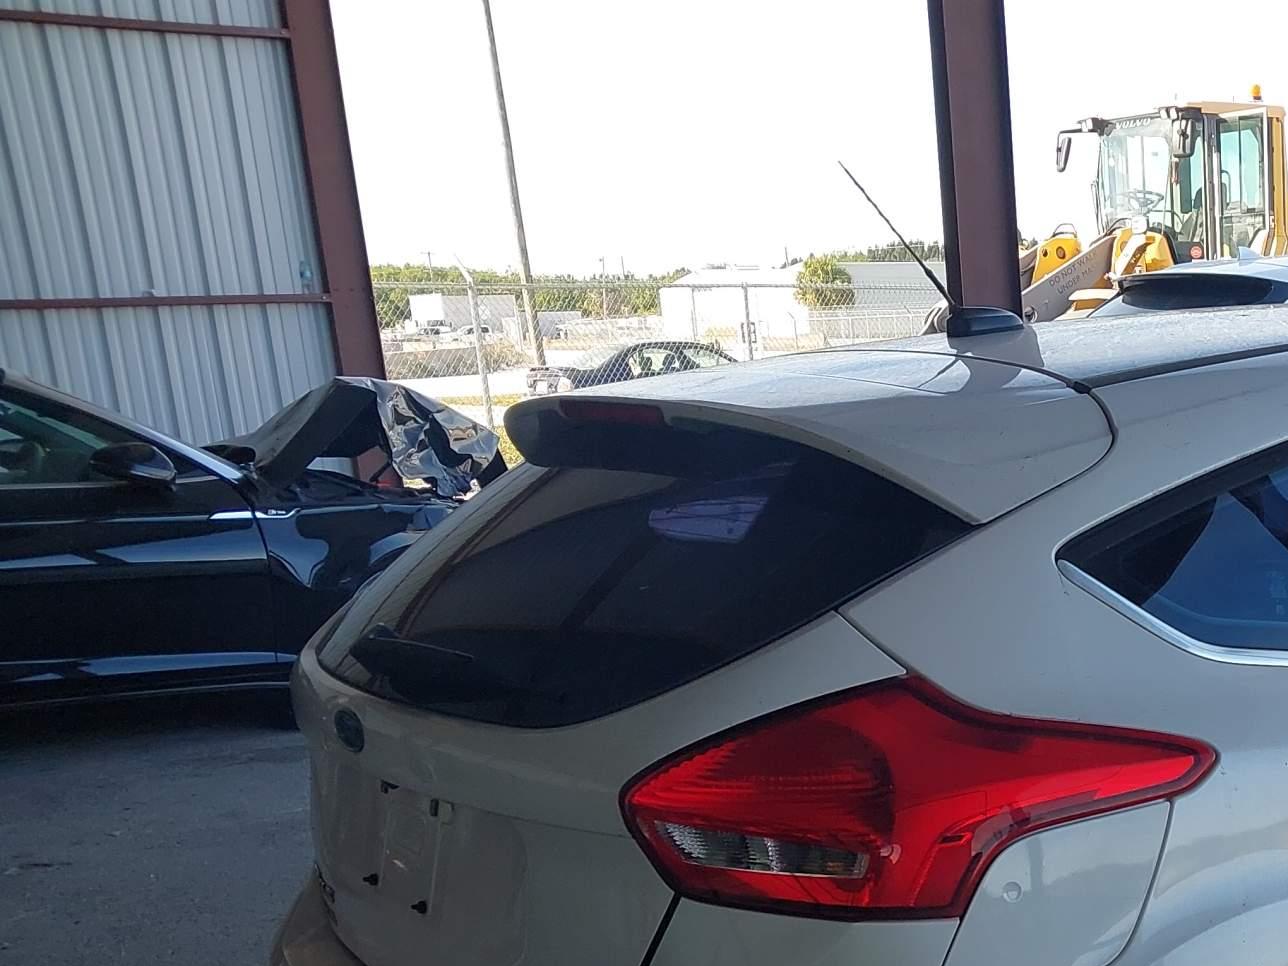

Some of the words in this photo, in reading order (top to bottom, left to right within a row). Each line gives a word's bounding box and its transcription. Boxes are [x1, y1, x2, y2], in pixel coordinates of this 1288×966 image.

[1115, 117, 1151, 129] VOLVO
[1049, 275, 1061, 287] DO
[1061, 263, 1077, 279] NOT
[1057, 274, 1081, 295] UNDER
